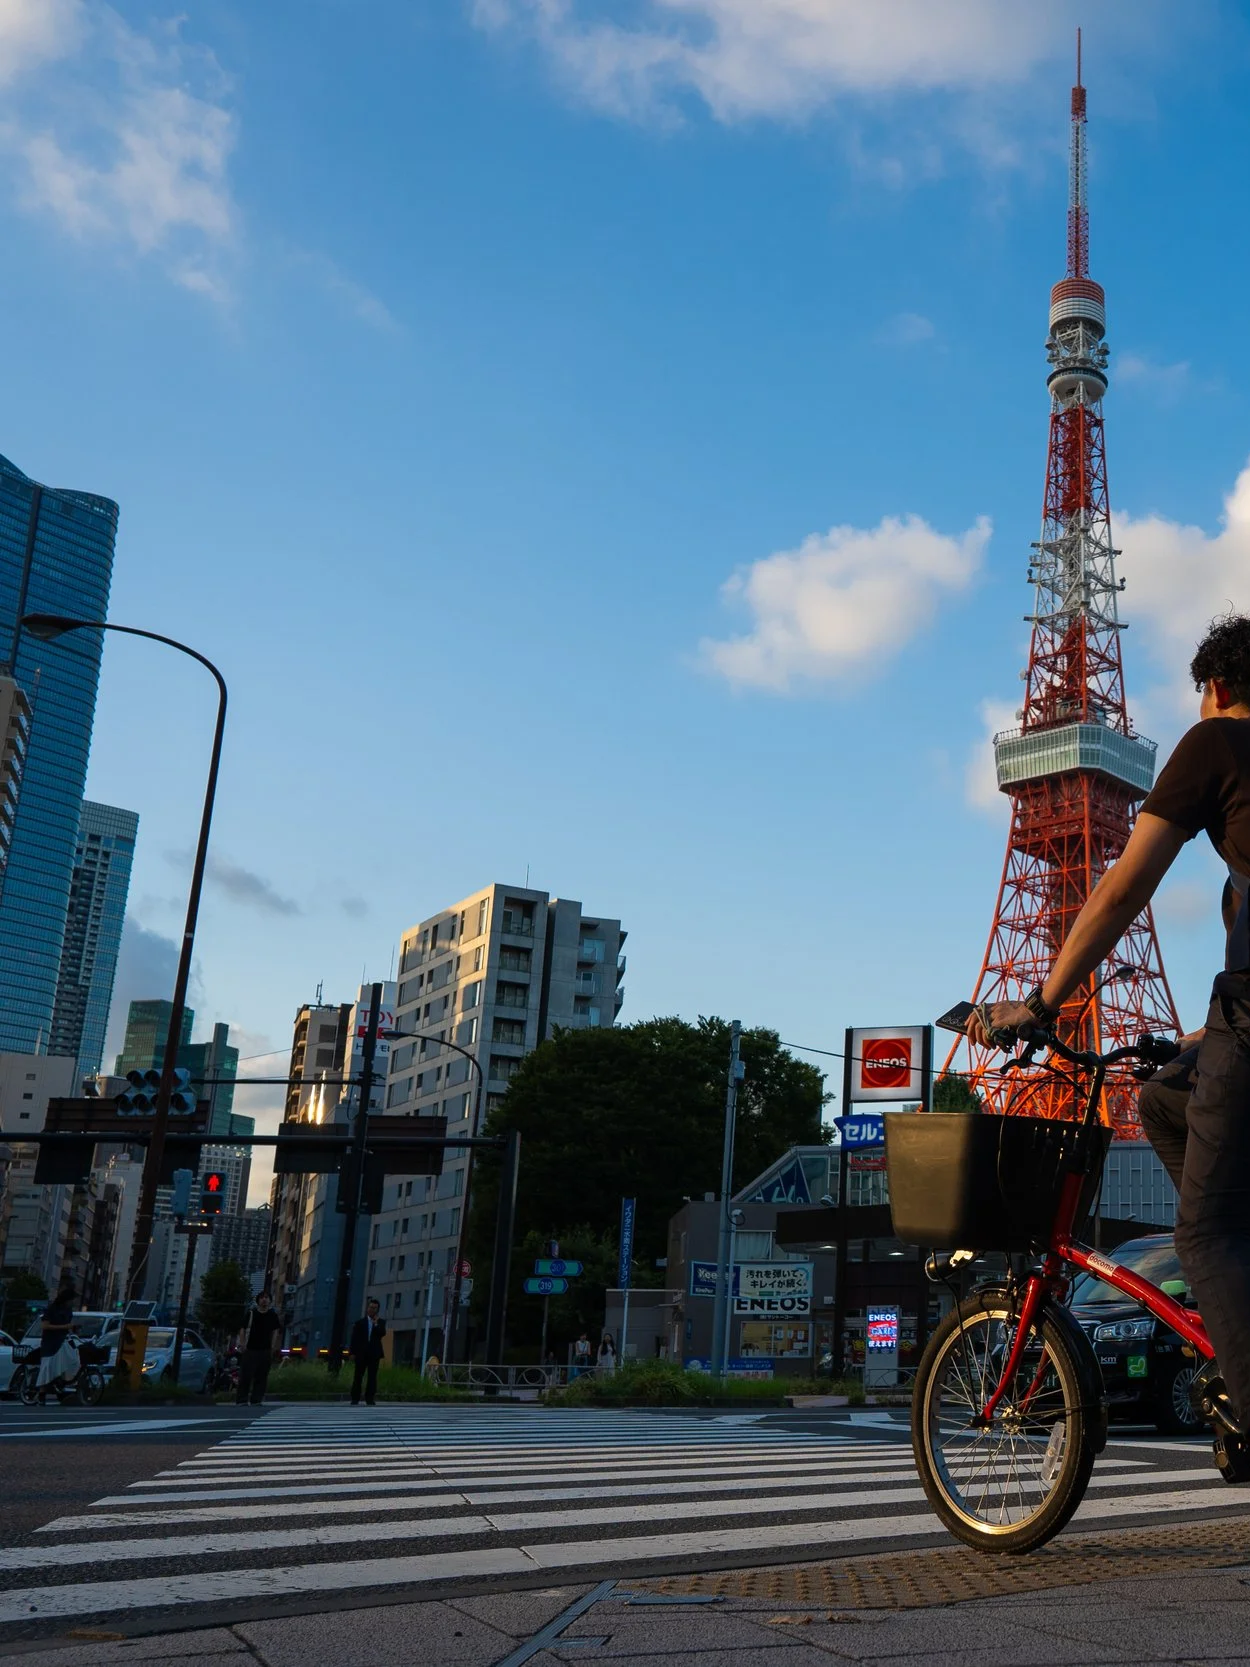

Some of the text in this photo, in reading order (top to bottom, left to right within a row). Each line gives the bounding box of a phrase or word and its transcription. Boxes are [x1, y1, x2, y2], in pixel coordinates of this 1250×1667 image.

[865, 1057, 907, 1069] ENEOS
[1089, 1254, 1115, 1273] docomo
[540, 1281, 552, 1290] 319
[736, 1297, 809, 1311] ENEOS
[868, 1313, 897, 1321] ENEOS
